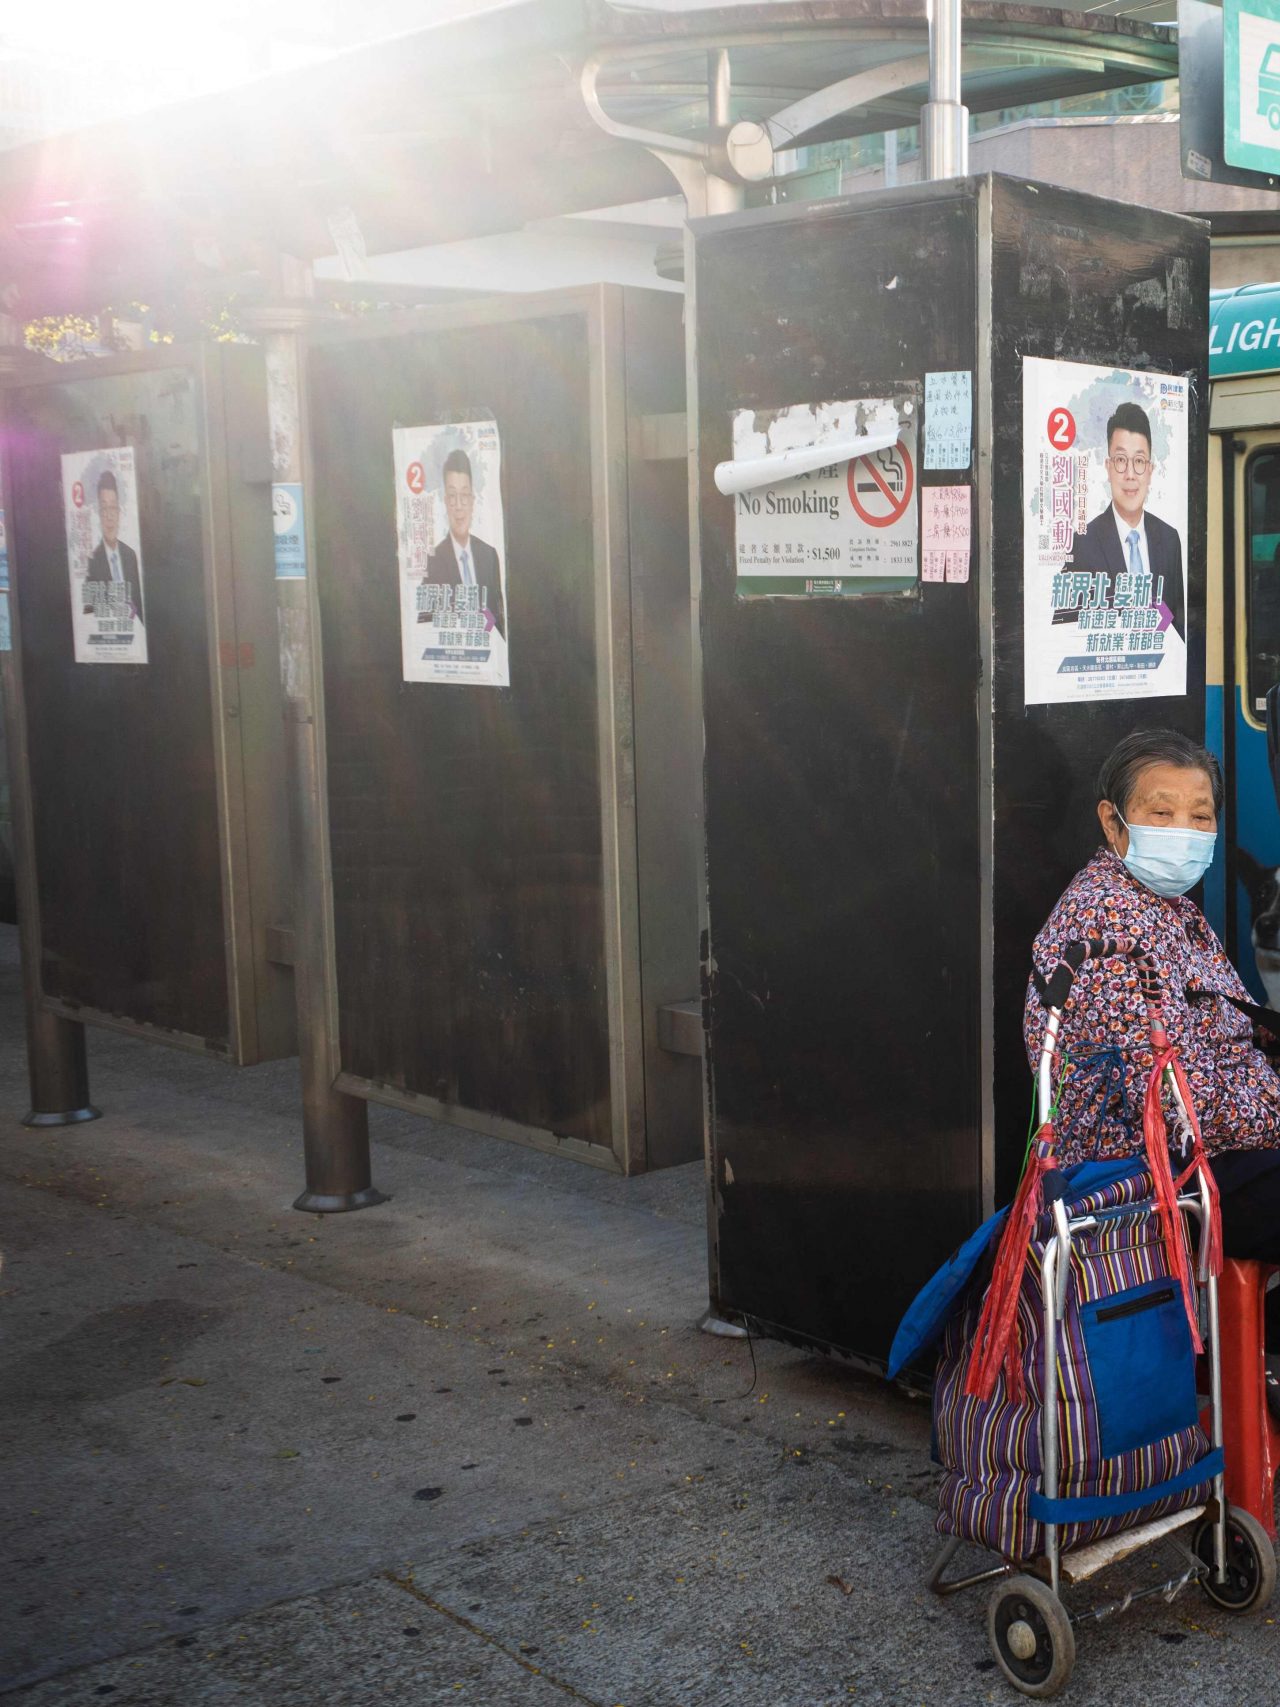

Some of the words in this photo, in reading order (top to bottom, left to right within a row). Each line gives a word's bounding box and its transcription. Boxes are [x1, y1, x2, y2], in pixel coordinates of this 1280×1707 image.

[1053, 413, 1069, 443] 2
[410, 466, 422, 487] 2
[739, 492, 761, 515] No
[766, 489, 839, 520] Smoking
[1052, 455, 1073, 551] 劉國勳
[739, 556, 752, 564] Fixed
[753, 556, 771, 566] Penalty
[781, 556, 804, 564] Violation
[812, 547, 841, 561] $1,500
[1051, 572, 1111, 609] 新界北
[1078, 609, 1118, 630] 新速度
[1121, 609, 1159, 629] 新鐵路
[1086, 633, 1125, 653] 新就業
[1128, 631, 1165, 651] 新都會
